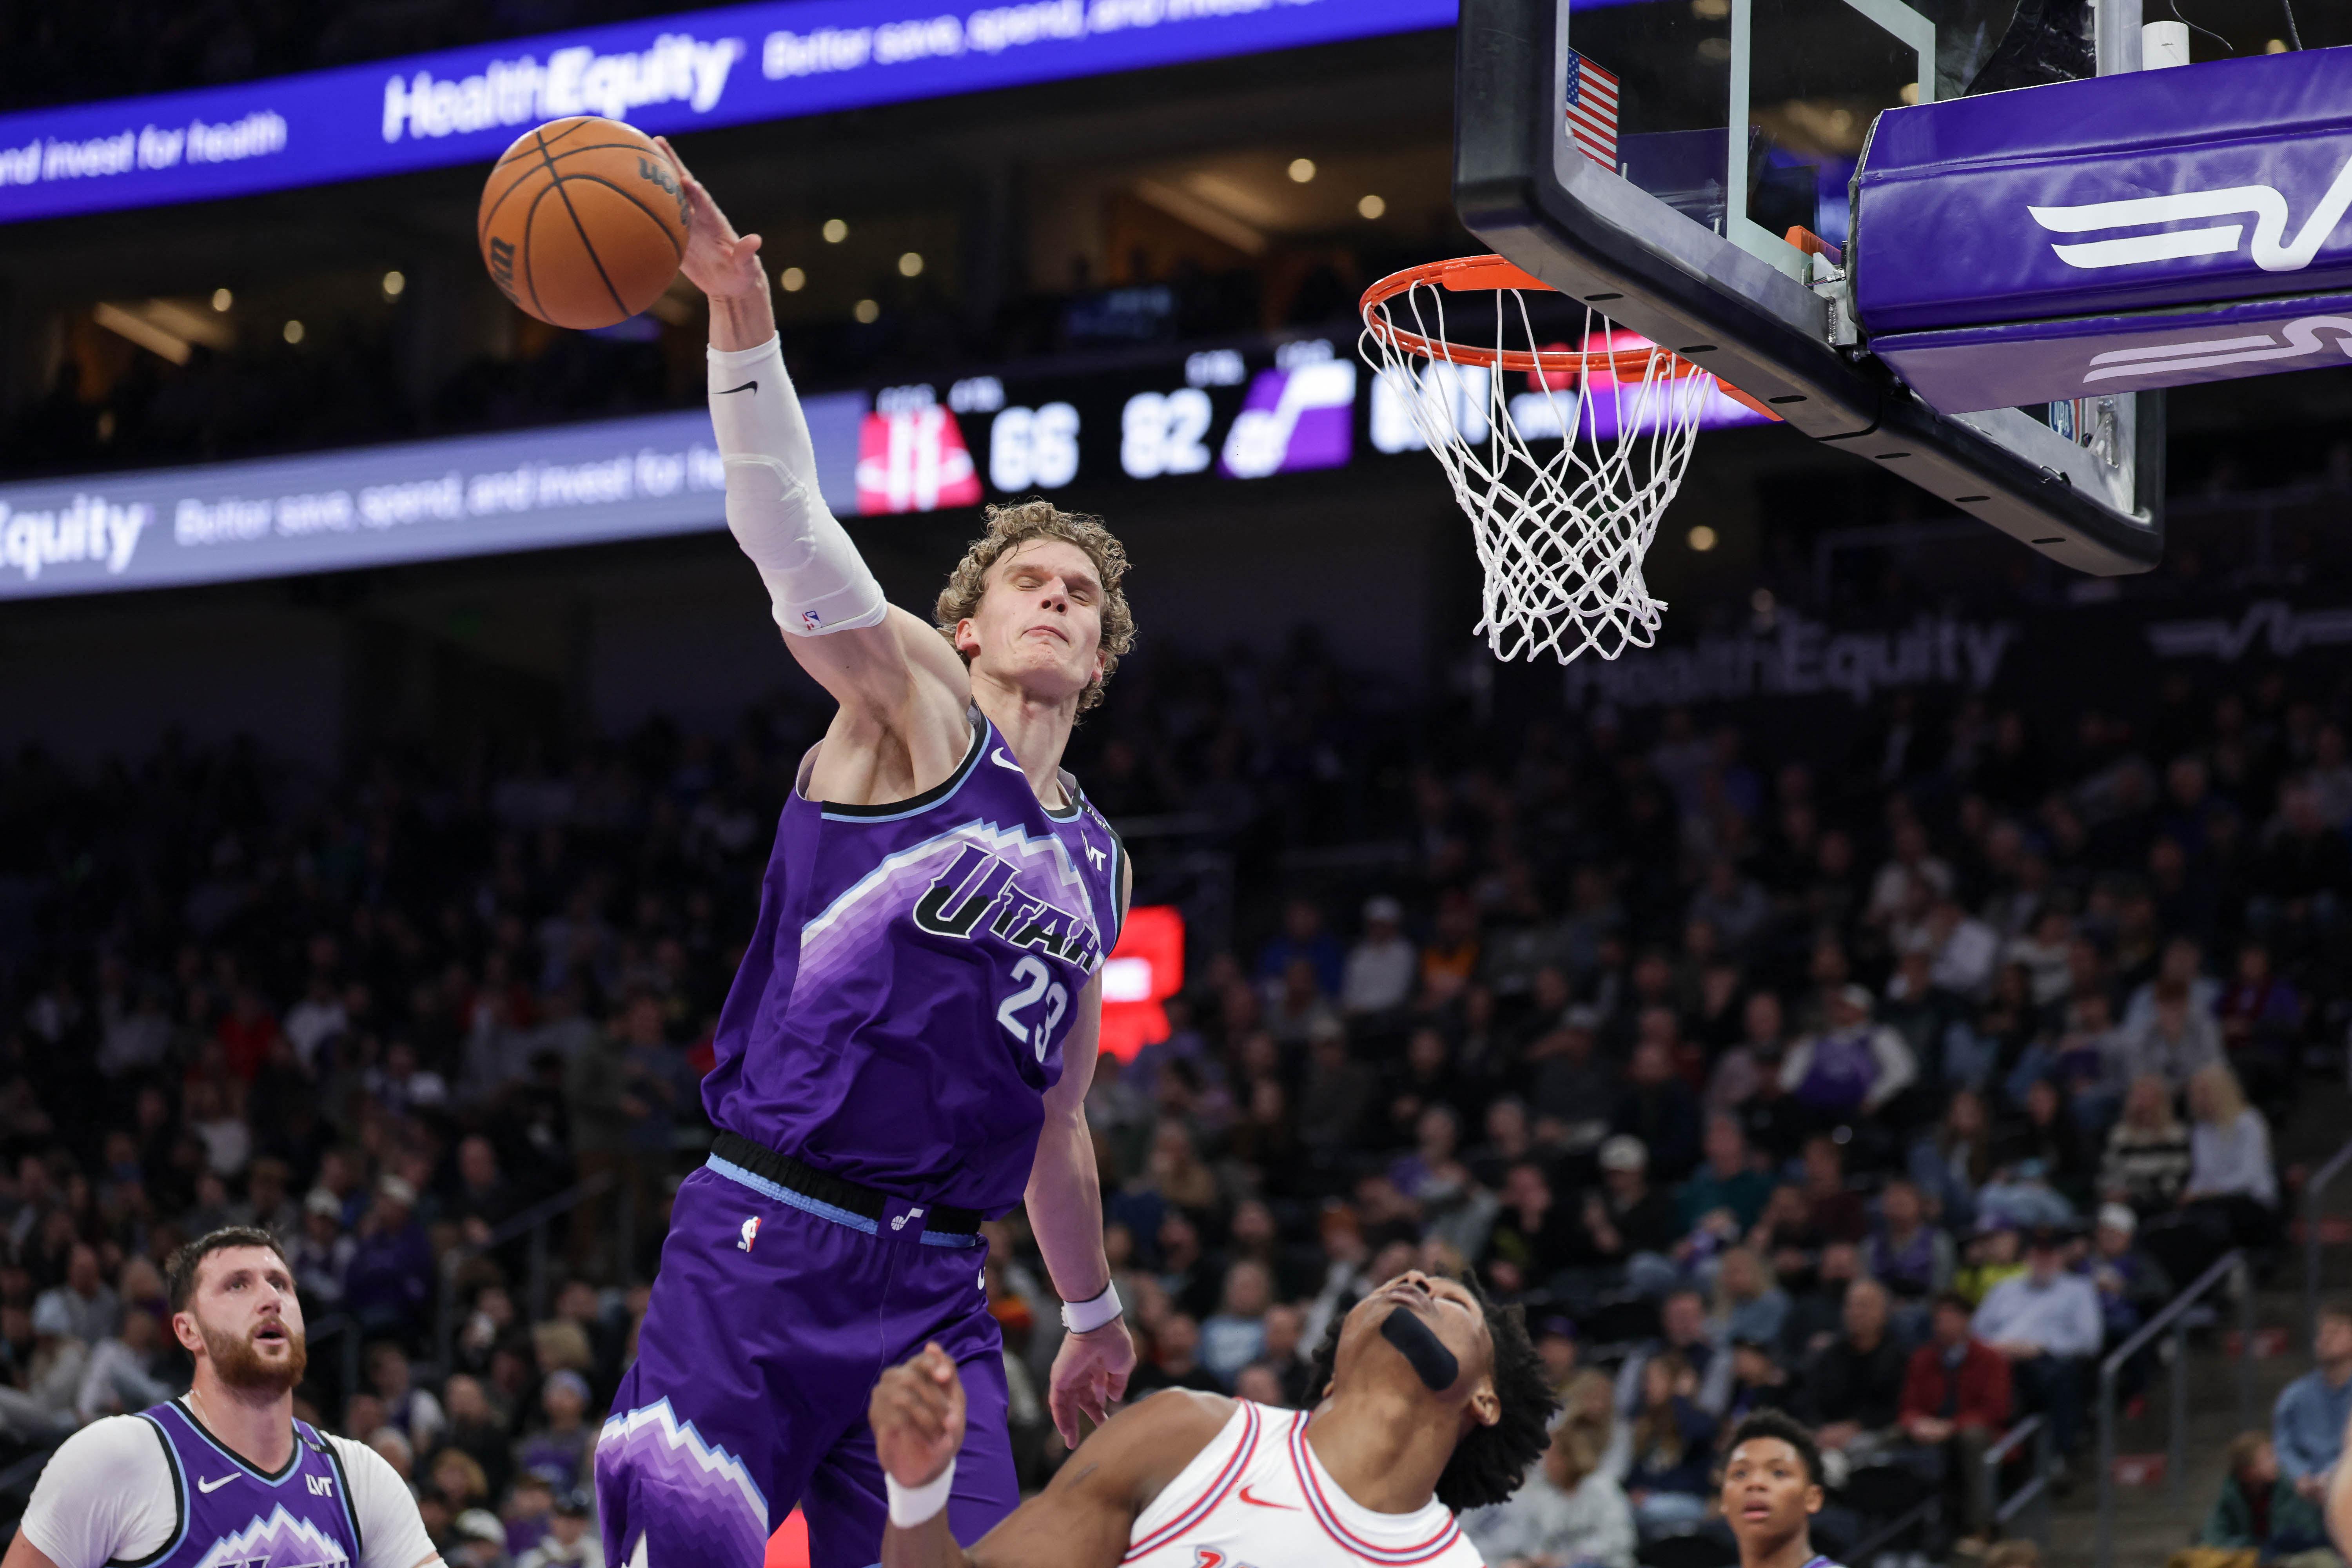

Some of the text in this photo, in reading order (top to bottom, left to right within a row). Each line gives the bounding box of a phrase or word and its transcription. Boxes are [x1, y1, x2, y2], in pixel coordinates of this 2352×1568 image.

[381, 33, 734, 143] HealthEquity
[137, 123, 185, 170] for
[1121, 388, 1212, 479] 82
[912, 840, 1101, 976] UTAH
[996, 955, 1068, 1063] 23
